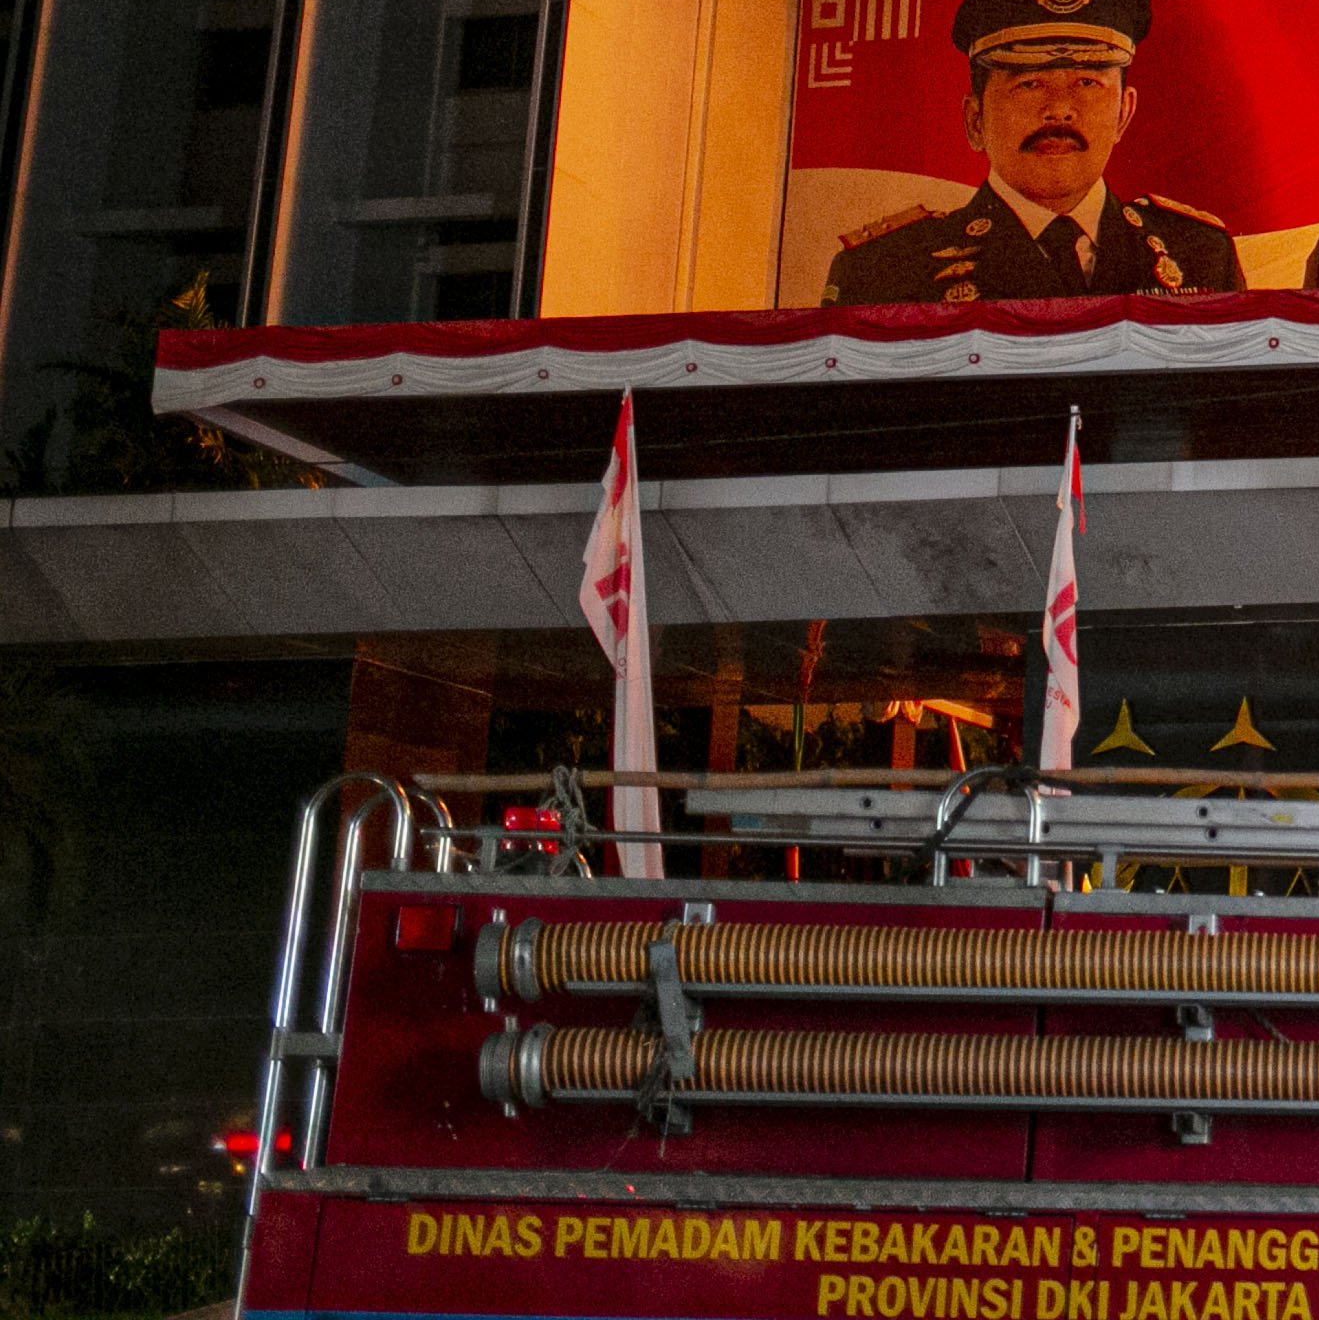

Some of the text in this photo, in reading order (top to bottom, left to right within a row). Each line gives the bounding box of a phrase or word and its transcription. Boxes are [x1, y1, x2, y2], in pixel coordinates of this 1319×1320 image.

[407, 1213, 542, 1257] DINAS
[555, 1216, 781, 1260] PEMADAM
[794, 1220, 1061, 1267] KEBAKARAN
[1072, 1226, 1097, 1267] &
[817, 1274, 1313, 1320] PROVINSI DKI JAKARTA
